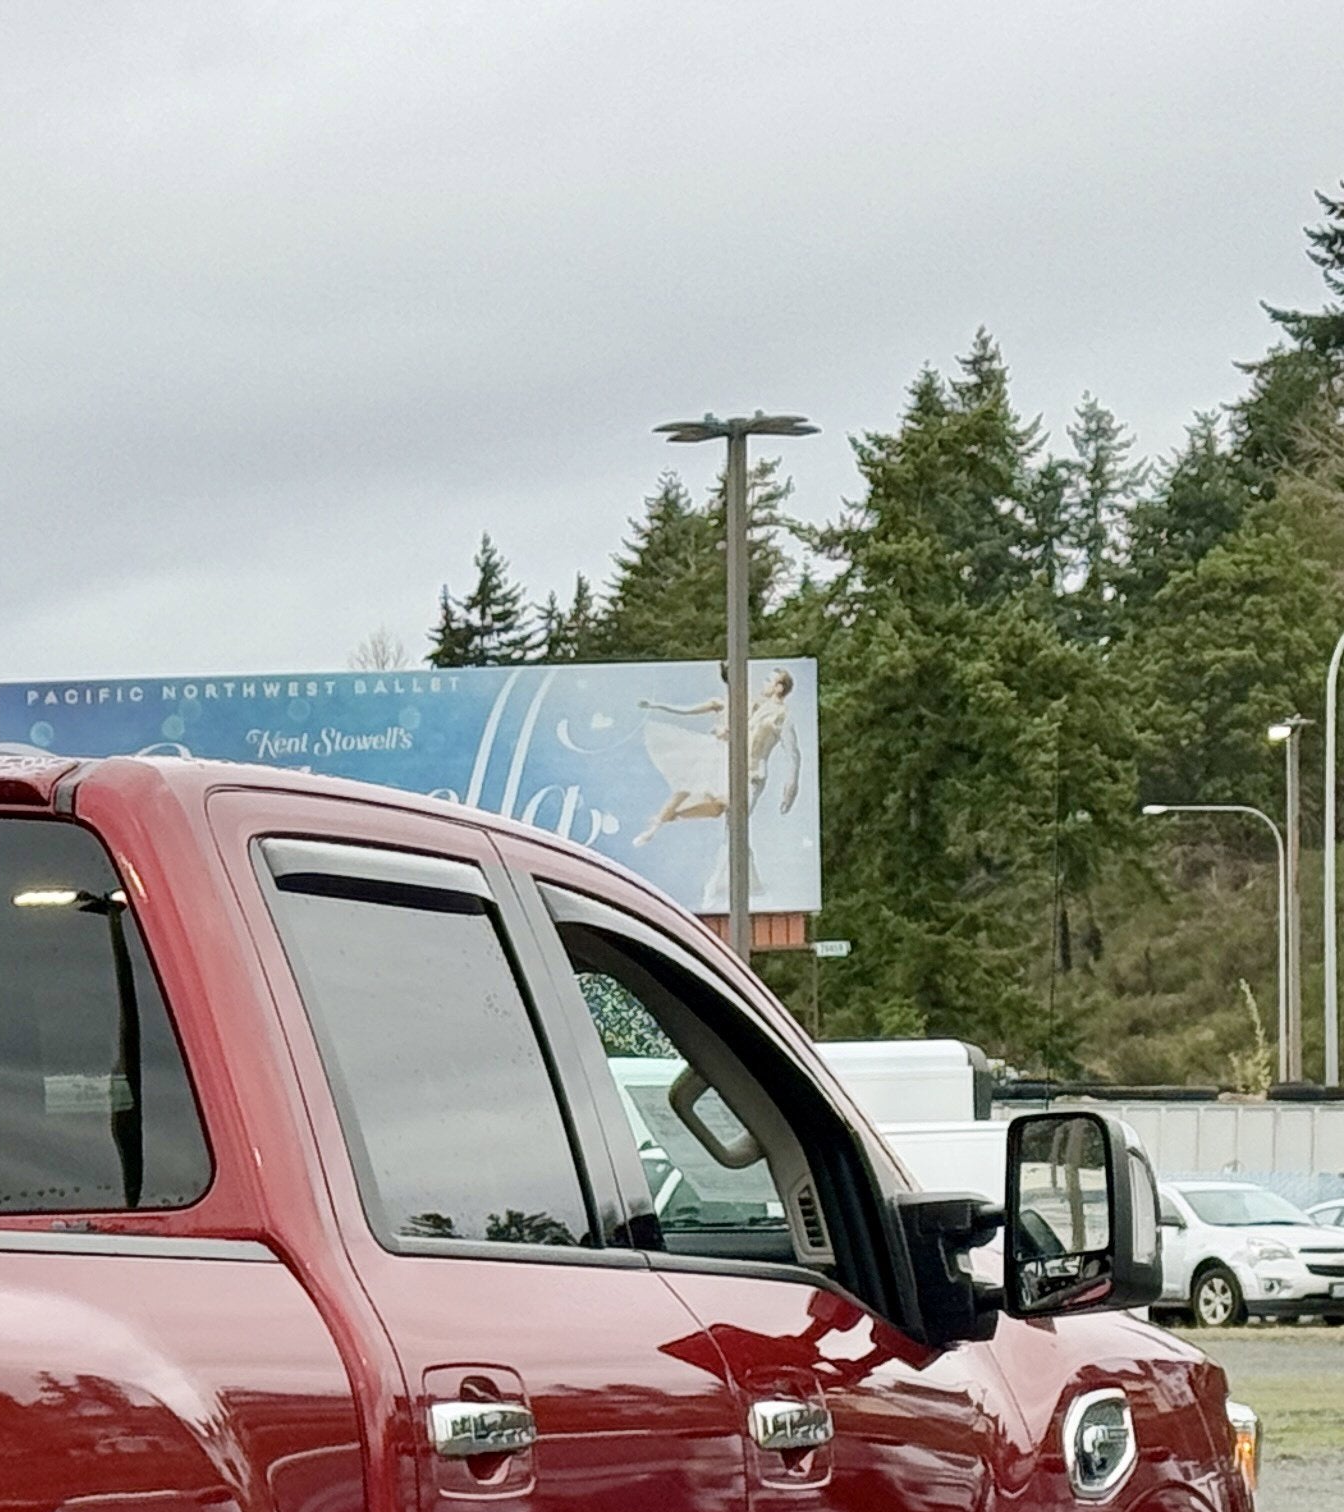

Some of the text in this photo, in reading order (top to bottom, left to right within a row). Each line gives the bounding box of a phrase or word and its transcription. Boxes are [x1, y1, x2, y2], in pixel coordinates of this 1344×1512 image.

[26, 676, 462, 706] PACIFIC NORTHWEST BALLET
[245, 728, 309, 759] Kent
